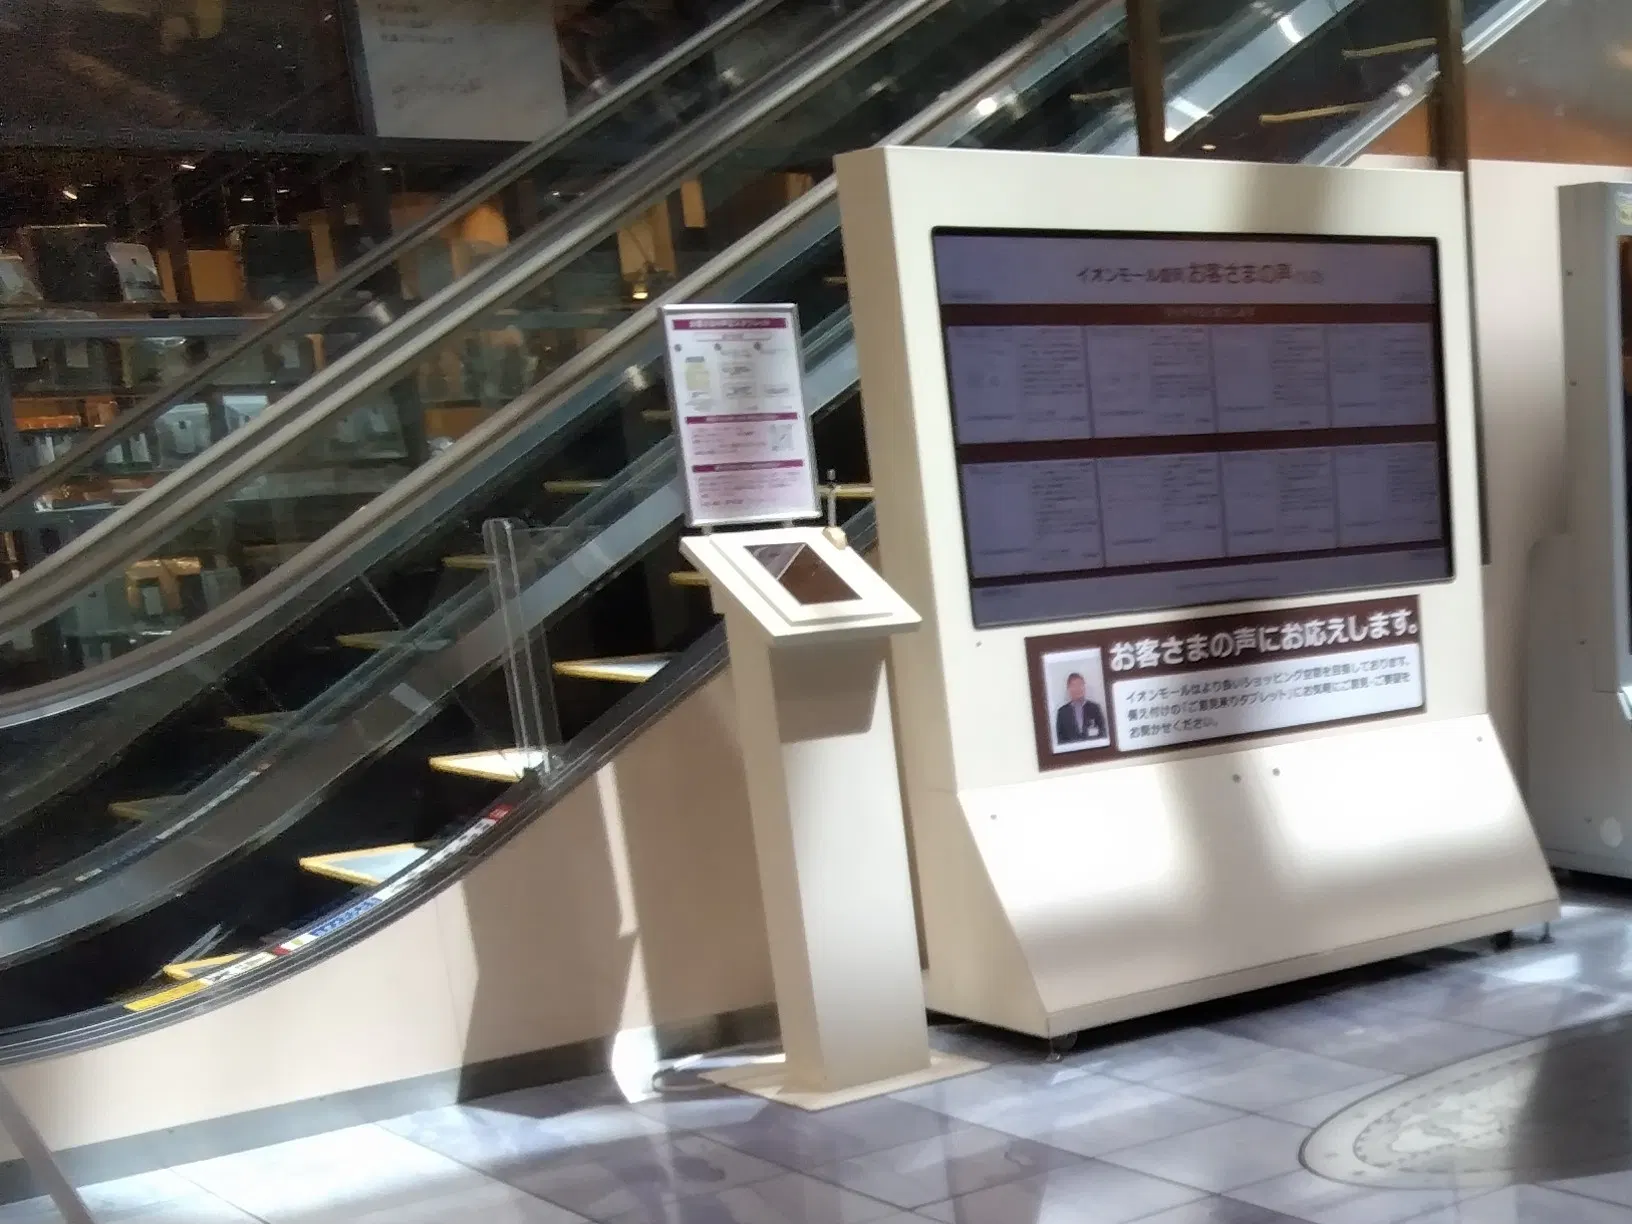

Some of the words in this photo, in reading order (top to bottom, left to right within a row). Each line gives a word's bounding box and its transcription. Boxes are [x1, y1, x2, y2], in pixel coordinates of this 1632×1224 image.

[1109, 609, 1418, 672] お客さまの声にお応えします。
